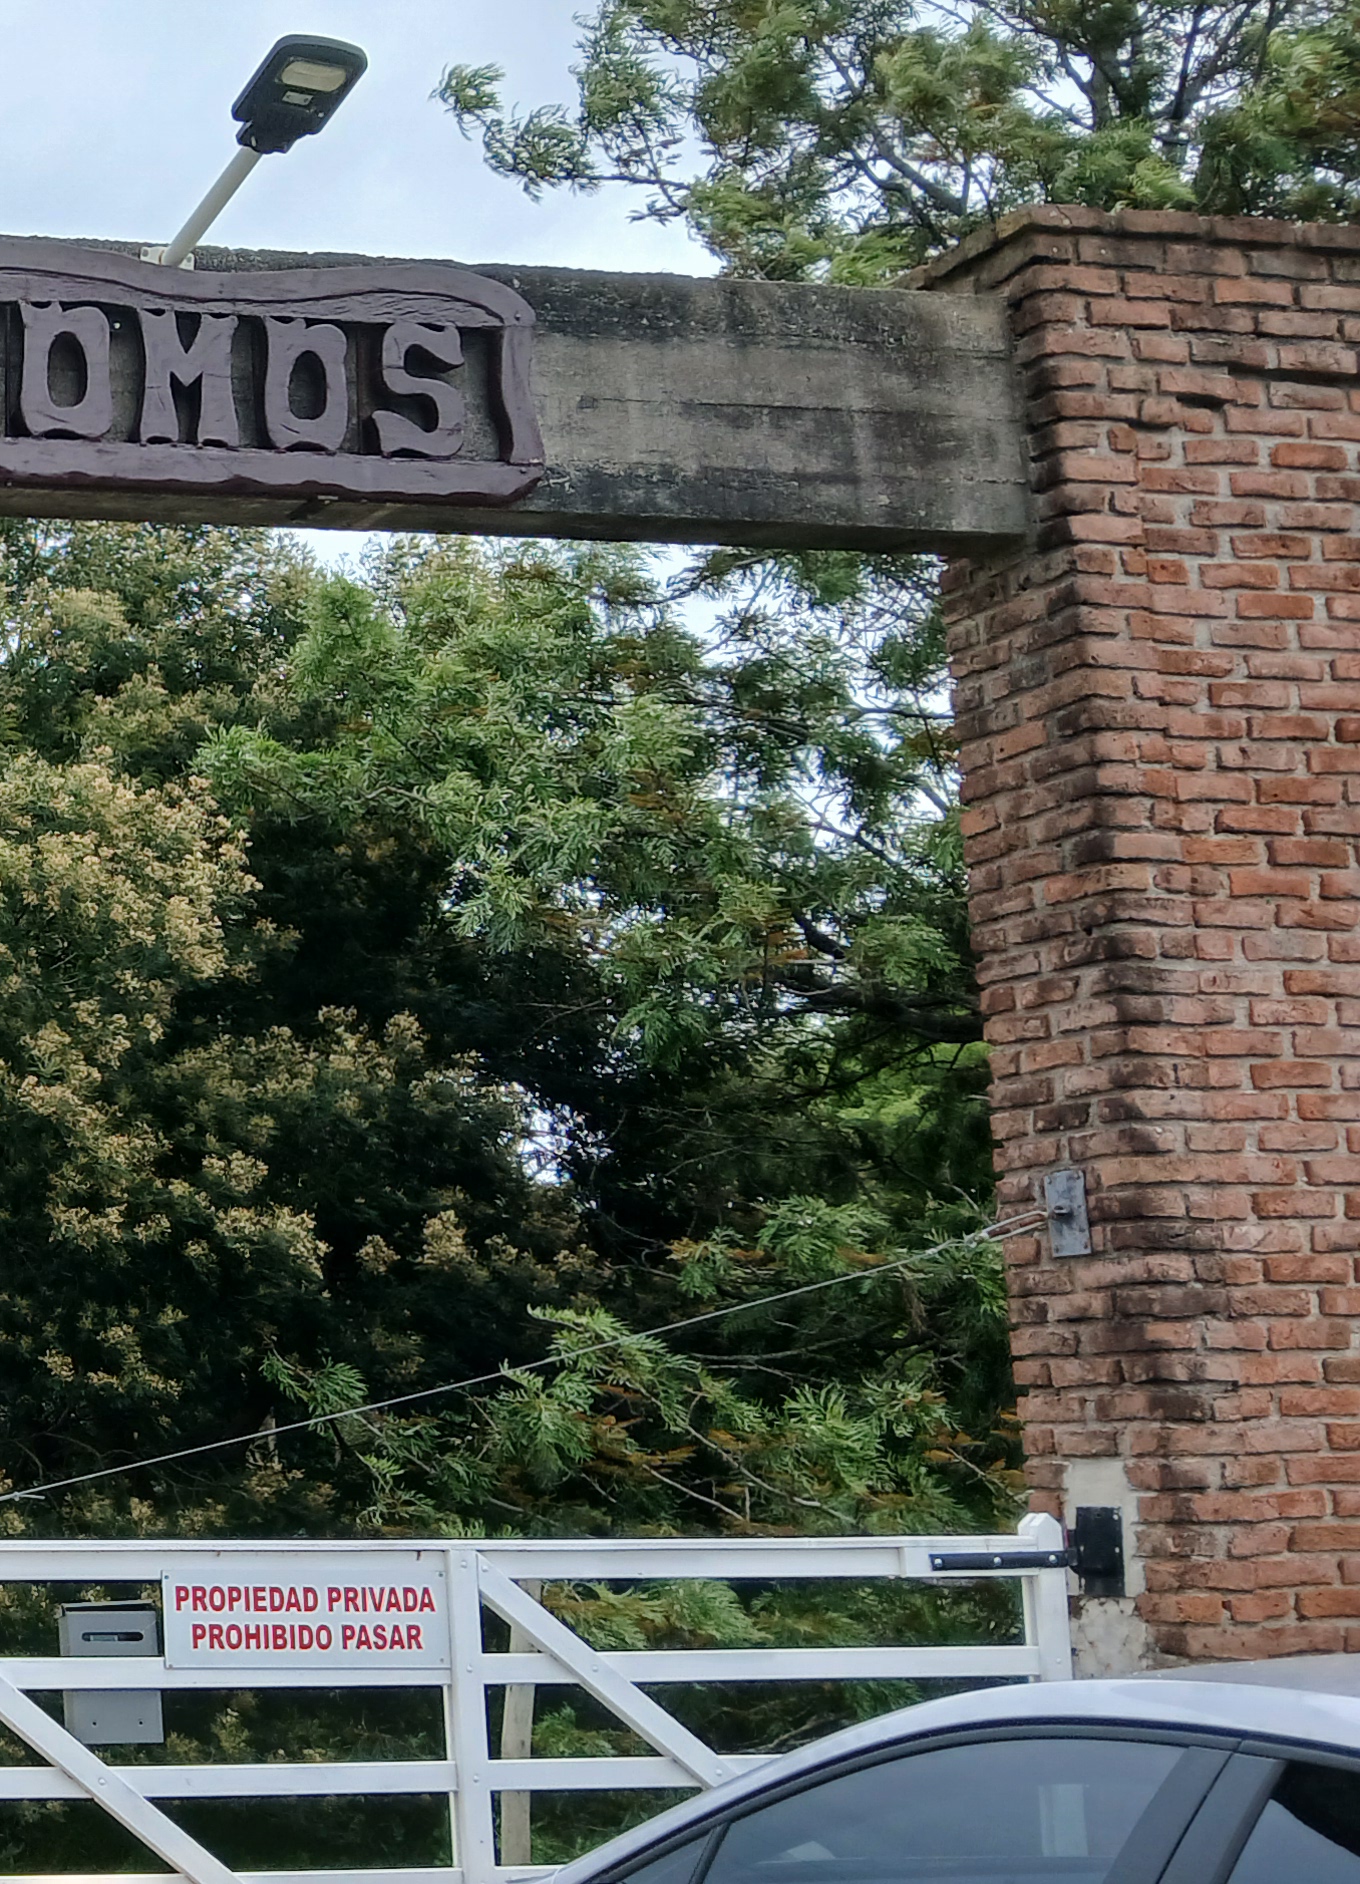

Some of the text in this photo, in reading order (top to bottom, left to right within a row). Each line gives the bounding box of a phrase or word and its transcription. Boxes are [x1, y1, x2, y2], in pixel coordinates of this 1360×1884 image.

[174, 1585, 436, 1613] PROPIEDAD PRIVADA
[191, 1623, 424, 1651] PROHIBIDO PASAR
